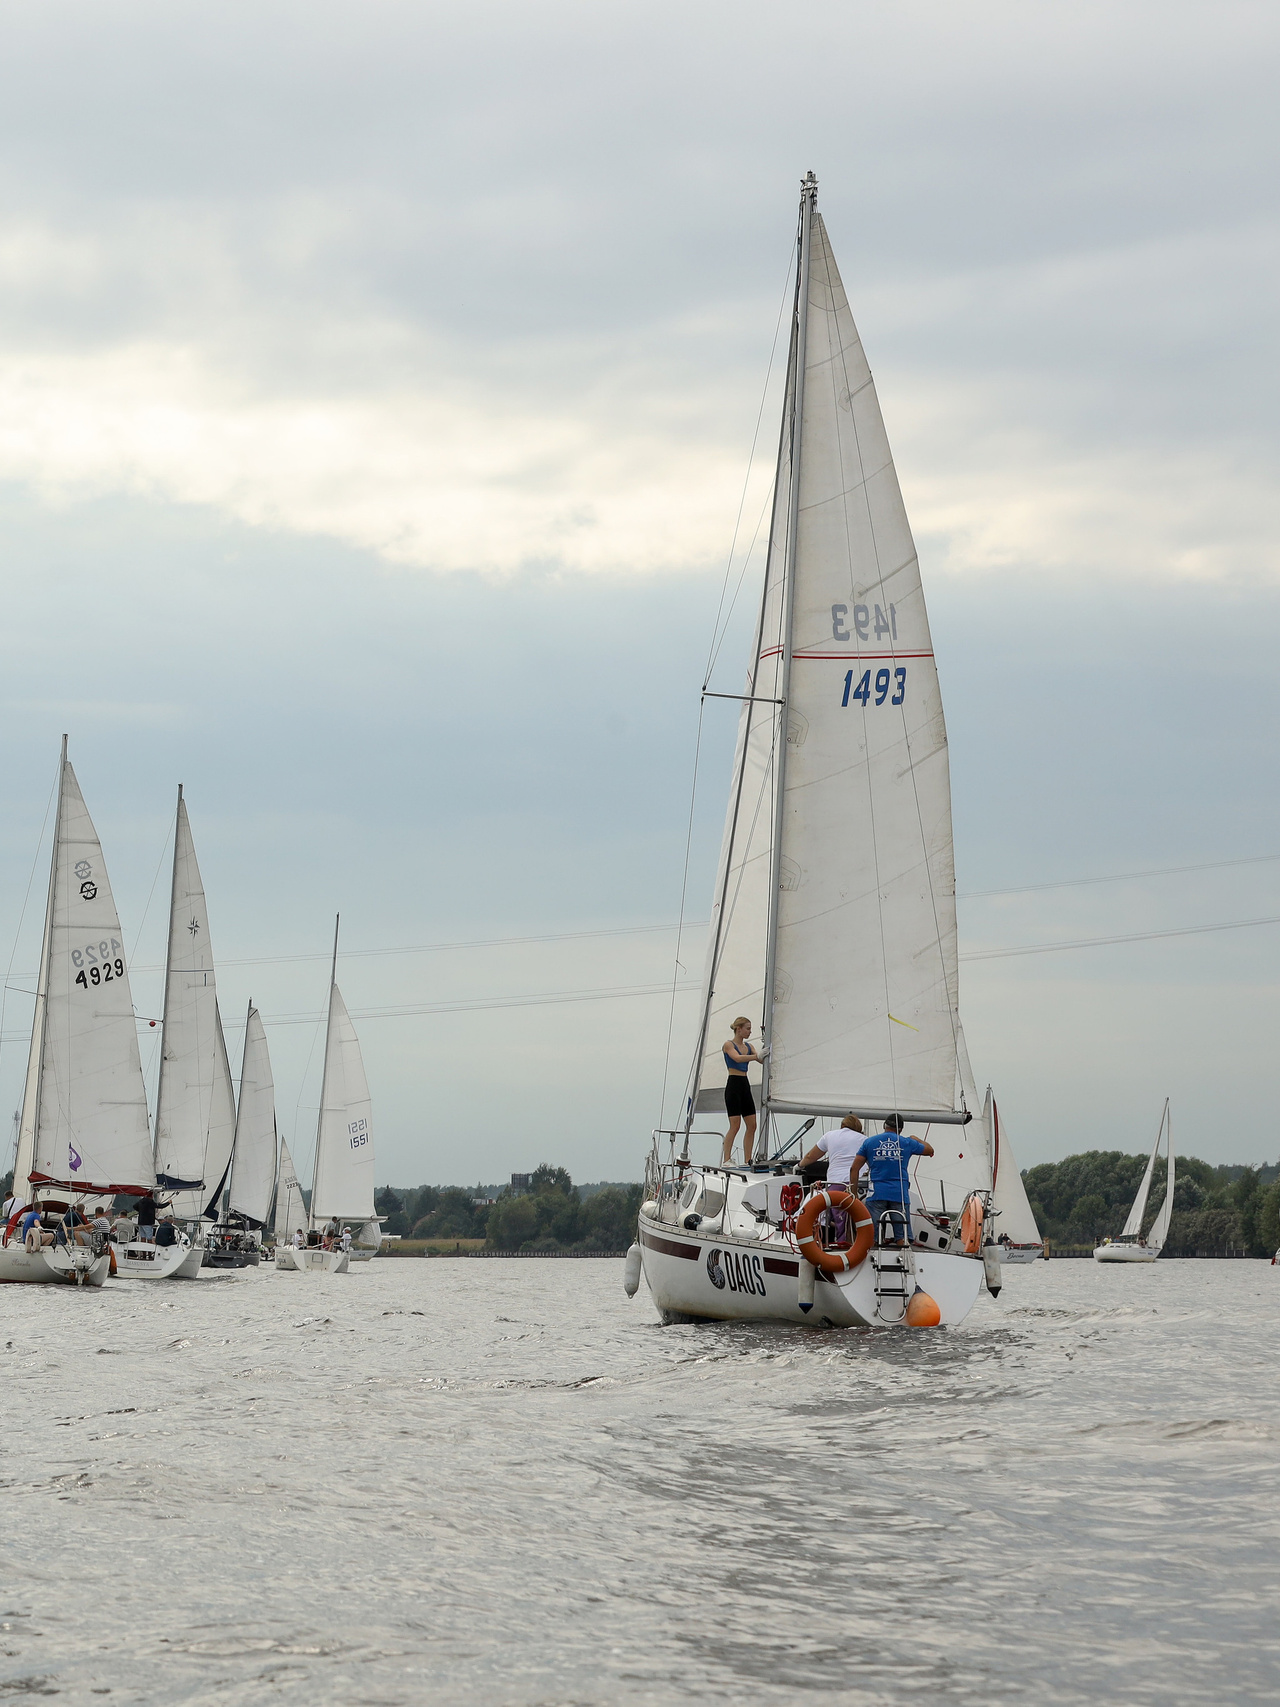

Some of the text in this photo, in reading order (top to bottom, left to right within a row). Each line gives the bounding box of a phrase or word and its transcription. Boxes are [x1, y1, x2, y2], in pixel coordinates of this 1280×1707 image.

[841, 667, 907, 707] 1493
[75, 958, 124, 989] 4929
[350, 1132, 369, 1149] 1551
[724, 1250, 767, 1297] DAOS
